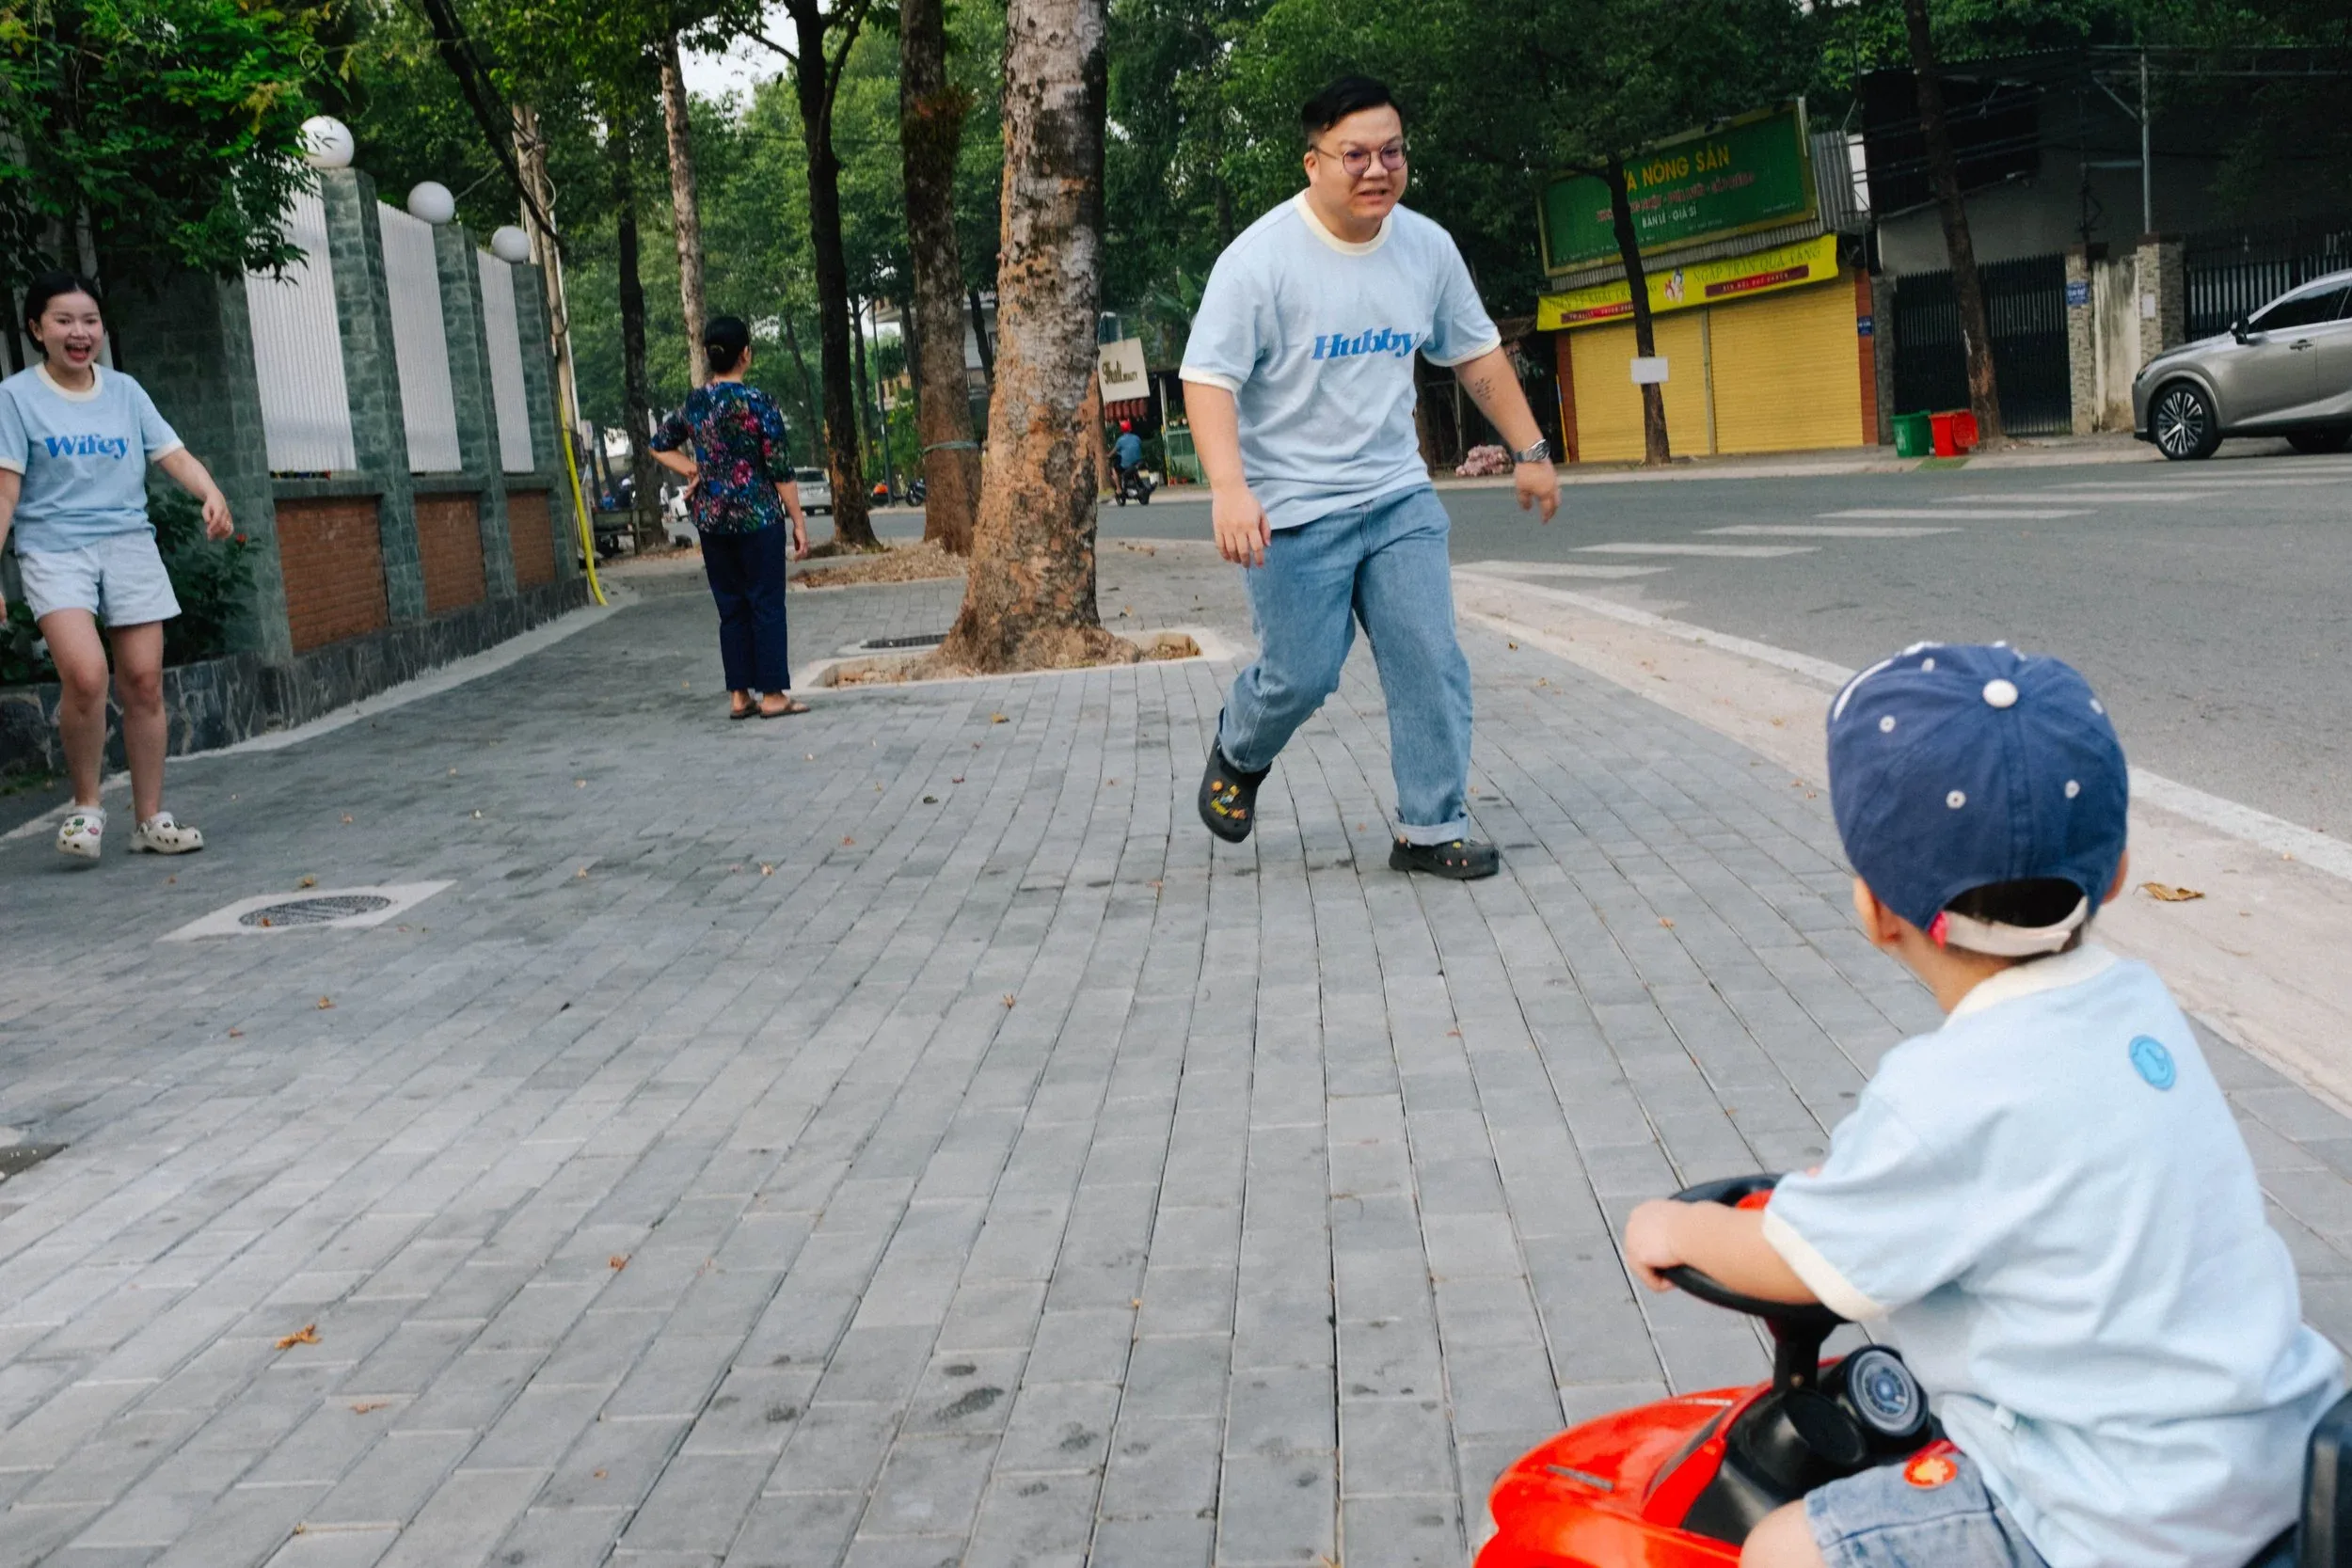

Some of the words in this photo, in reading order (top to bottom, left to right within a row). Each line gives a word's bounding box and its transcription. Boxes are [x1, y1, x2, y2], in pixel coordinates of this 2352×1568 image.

[1642, 157, 1690, 187] NÔNG
[1695, 141, 1730, 173] SẢN
[1311, 326, 1420, 360] Hubby
[45, 434, 129, 460] Wifey
